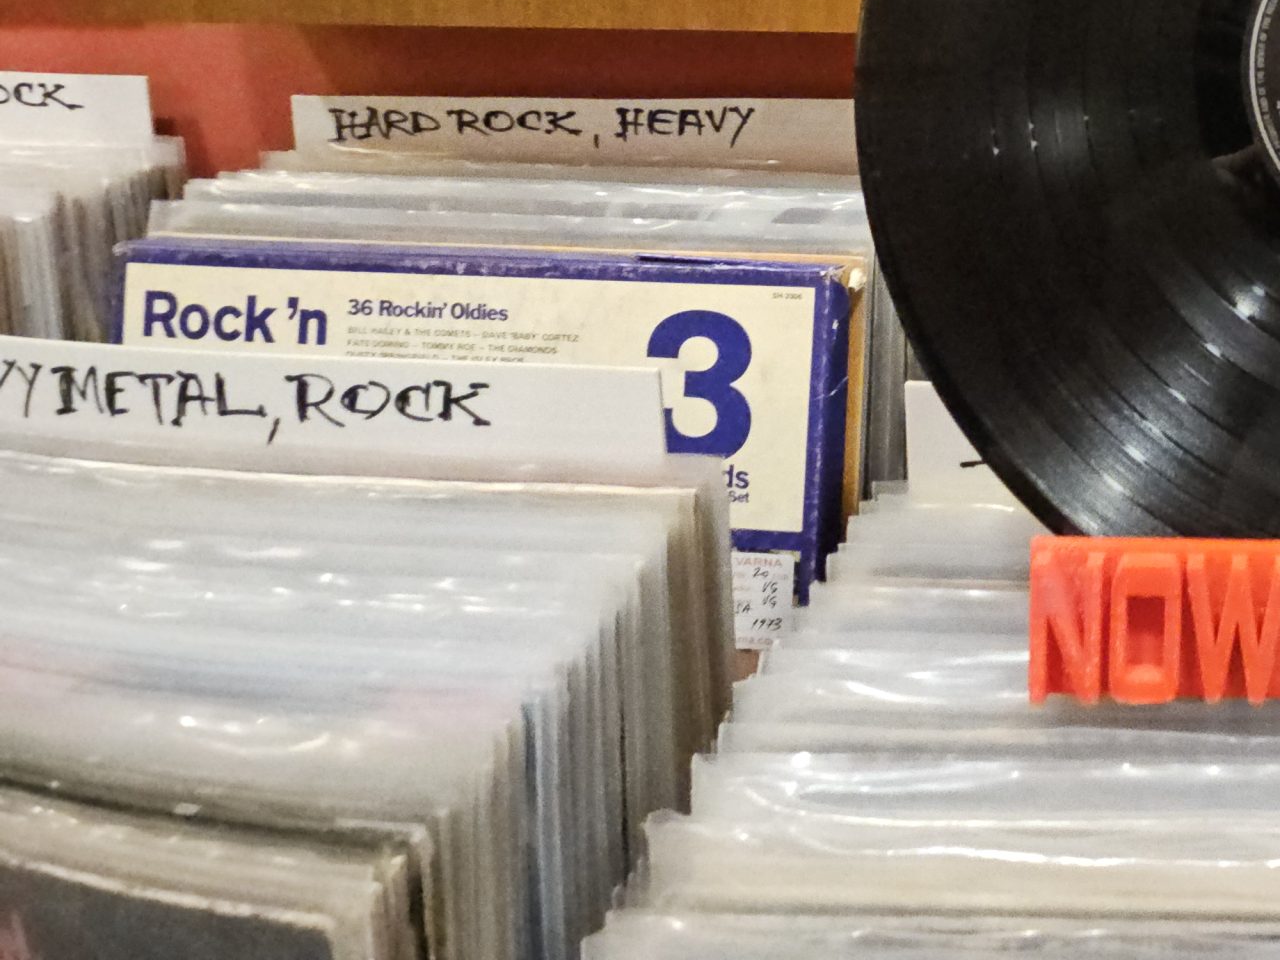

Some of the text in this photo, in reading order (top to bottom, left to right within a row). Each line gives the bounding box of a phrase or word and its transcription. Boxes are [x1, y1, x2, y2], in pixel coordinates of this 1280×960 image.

[328, 106, 441, 142] HARD
[614, 107, 756, 148] HEAVY
[143, 290, 327, 345] Rock 'n
[347, 298, 509, 321] 36 Rockin' Oldies
[285, 373, 491, 428] ROCK
[647, 310, 752, 459] 3
[735, 556, 783, 567] VARNA
[752, 616, 783, 632] 1973
